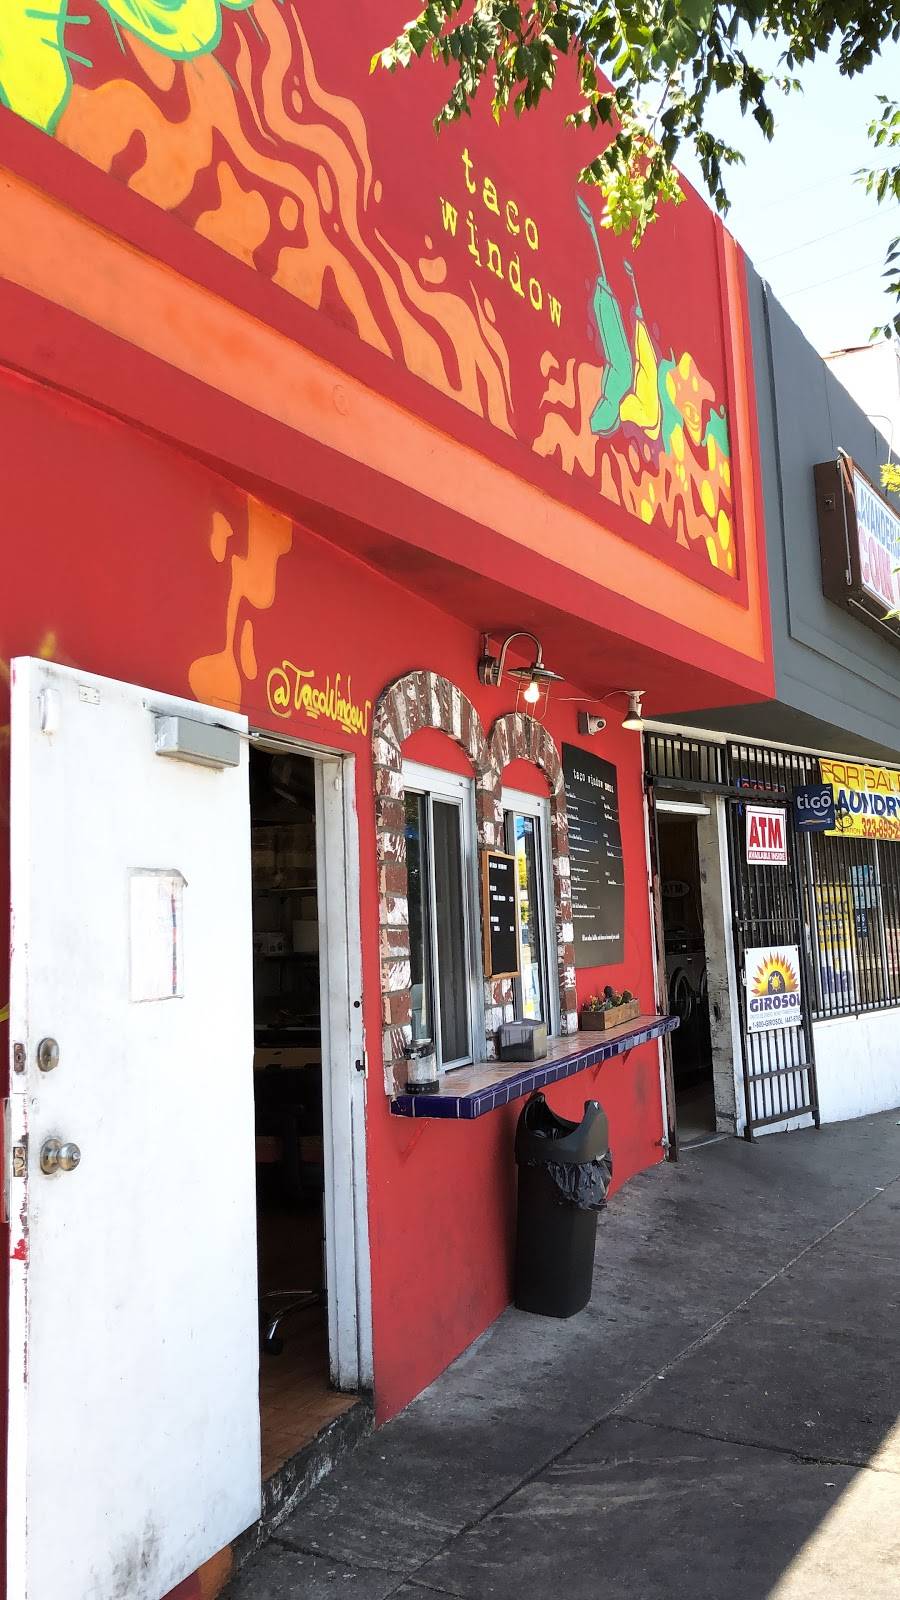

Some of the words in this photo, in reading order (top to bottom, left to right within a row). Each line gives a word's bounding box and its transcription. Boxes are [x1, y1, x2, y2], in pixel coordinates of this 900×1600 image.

[462, 147, 539, 250] taco
[439, 196, 561, 328] window
[820, 761, 860, 790] FOR
[749, 816, 783, 849] ATM
[748, 851, 771, 860] AVAILABLE
[771, 852, 786, 861] INSIDE
